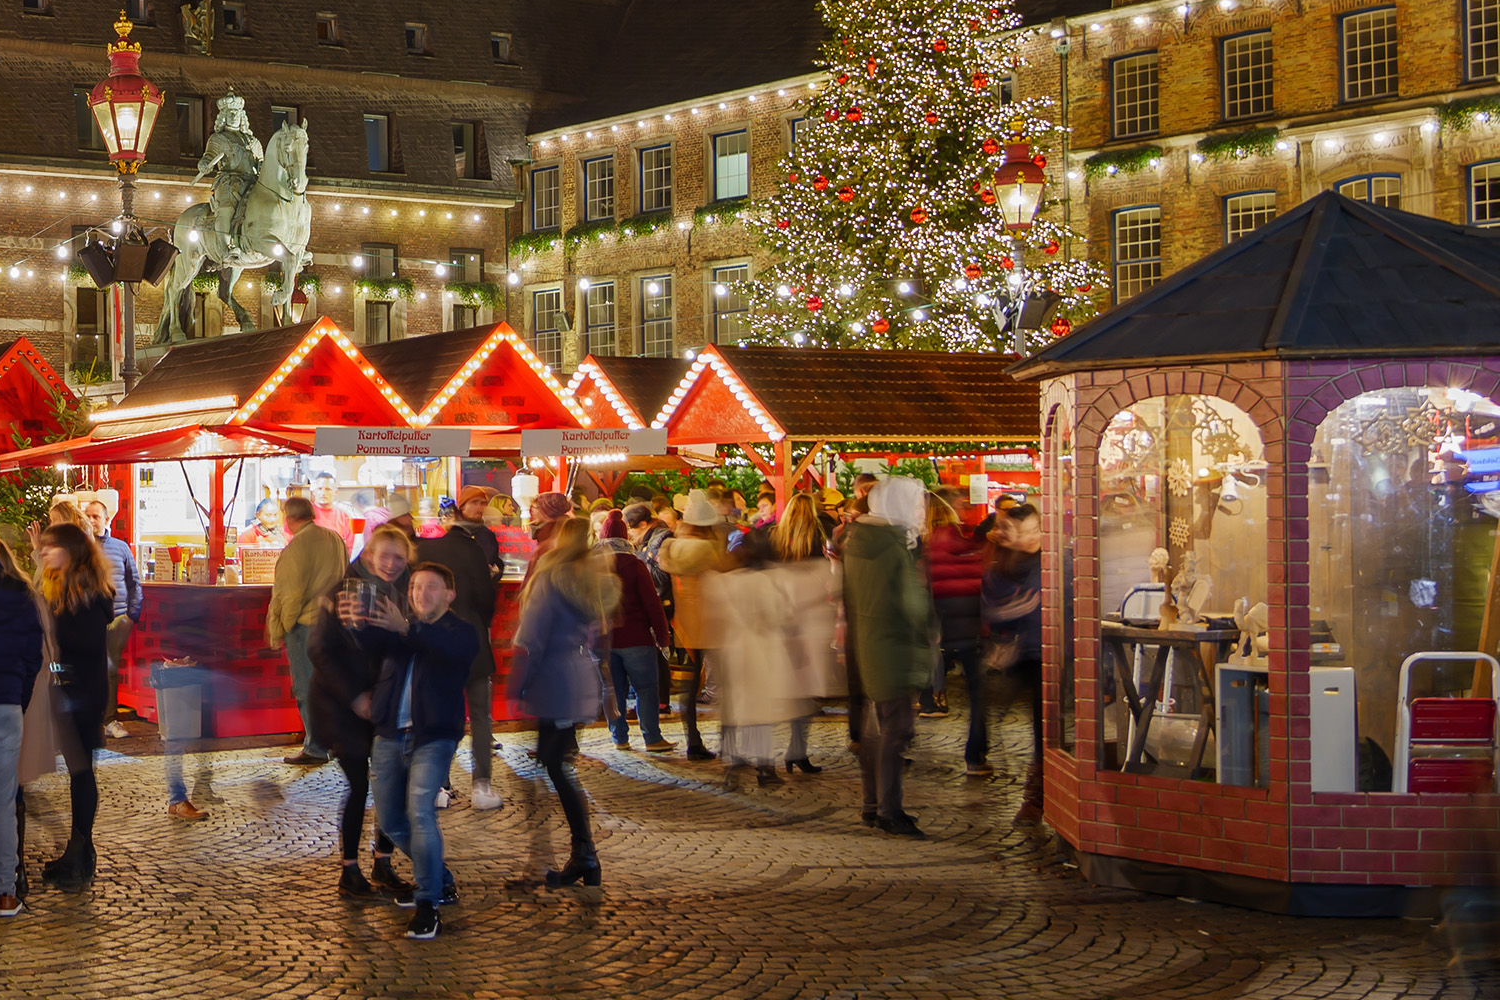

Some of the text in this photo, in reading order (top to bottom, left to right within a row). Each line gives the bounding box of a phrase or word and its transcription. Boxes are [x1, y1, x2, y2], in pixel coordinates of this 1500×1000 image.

[357, 429, 431, 442] Kartoffelpuffer
[561, 430, 630, 442] Kartoffelpuffer
[356, 443, 401, 454] Pommes
[560, 444, 603, 454] Pommes
